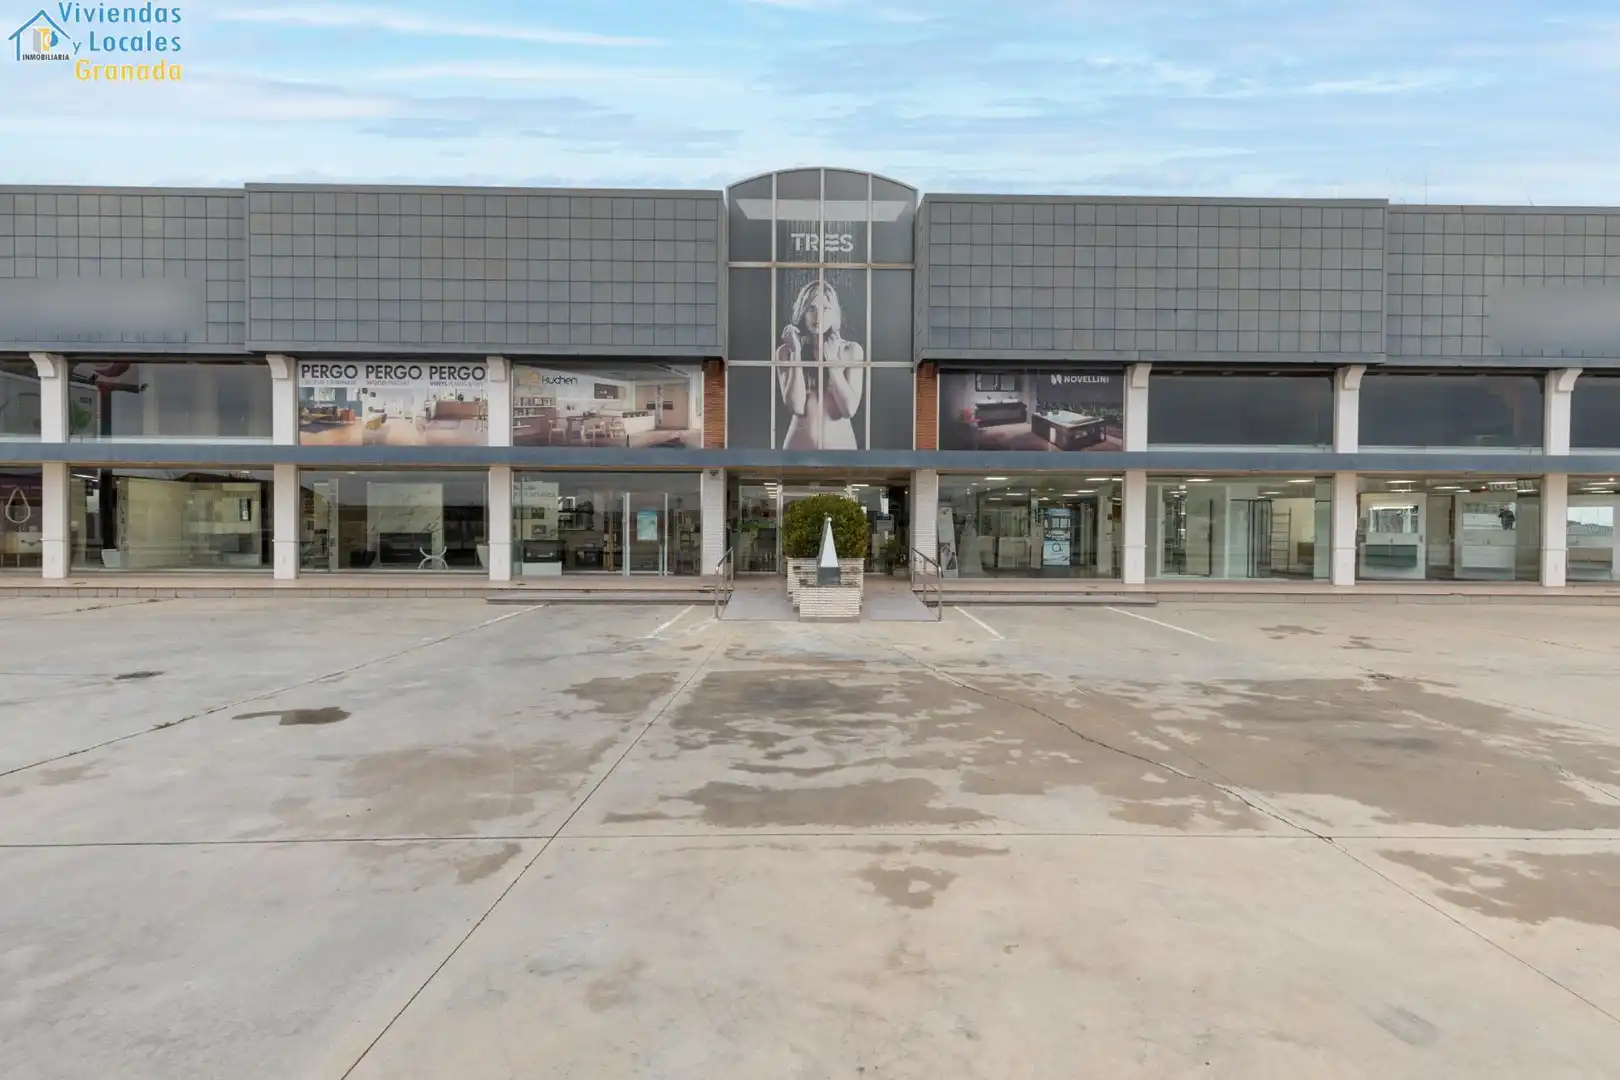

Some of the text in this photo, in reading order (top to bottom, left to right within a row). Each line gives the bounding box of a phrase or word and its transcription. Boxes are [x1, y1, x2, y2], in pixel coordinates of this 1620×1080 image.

[790, 233, 854, 252] TRES
[301, 364, 358, 379] PERGO
[365, 364, 422, 380] PERGO
[429, 365, 486, 381] PERGO
[1064, 375, 1110, 383] NOVELLINI
